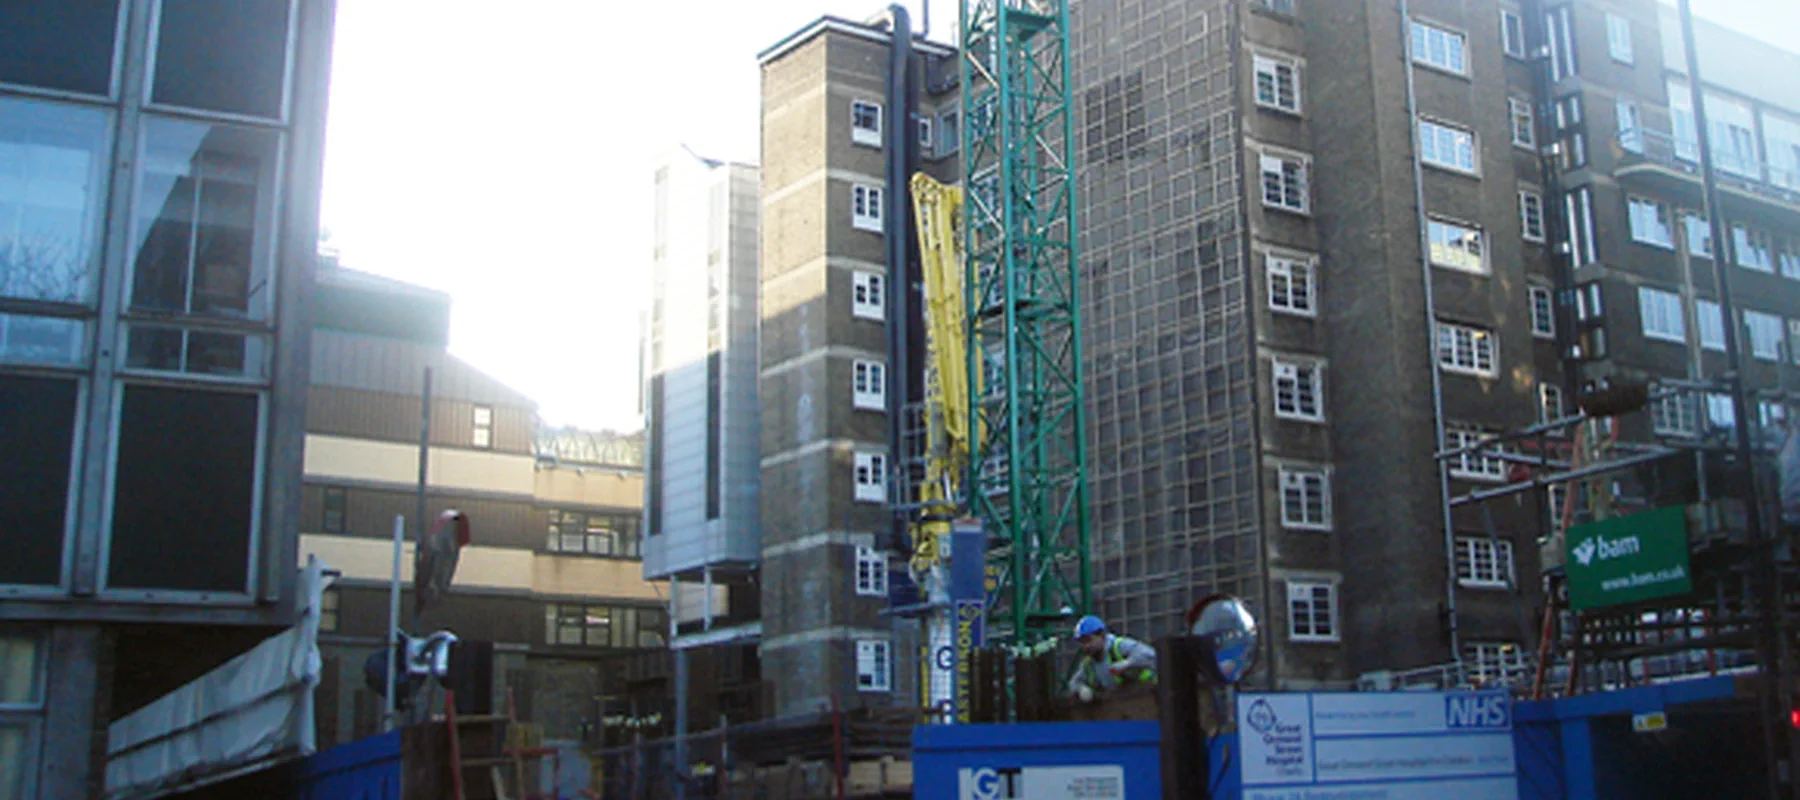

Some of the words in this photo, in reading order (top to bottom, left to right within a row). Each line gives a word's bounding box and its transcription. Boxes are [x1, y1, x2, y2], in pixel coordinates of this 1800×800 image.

[1598, 534, 1640, 559] bam
[1602, 565, 1685, 590] www.bam.co.uk
[1449, 696, 1507, 726] NHS
